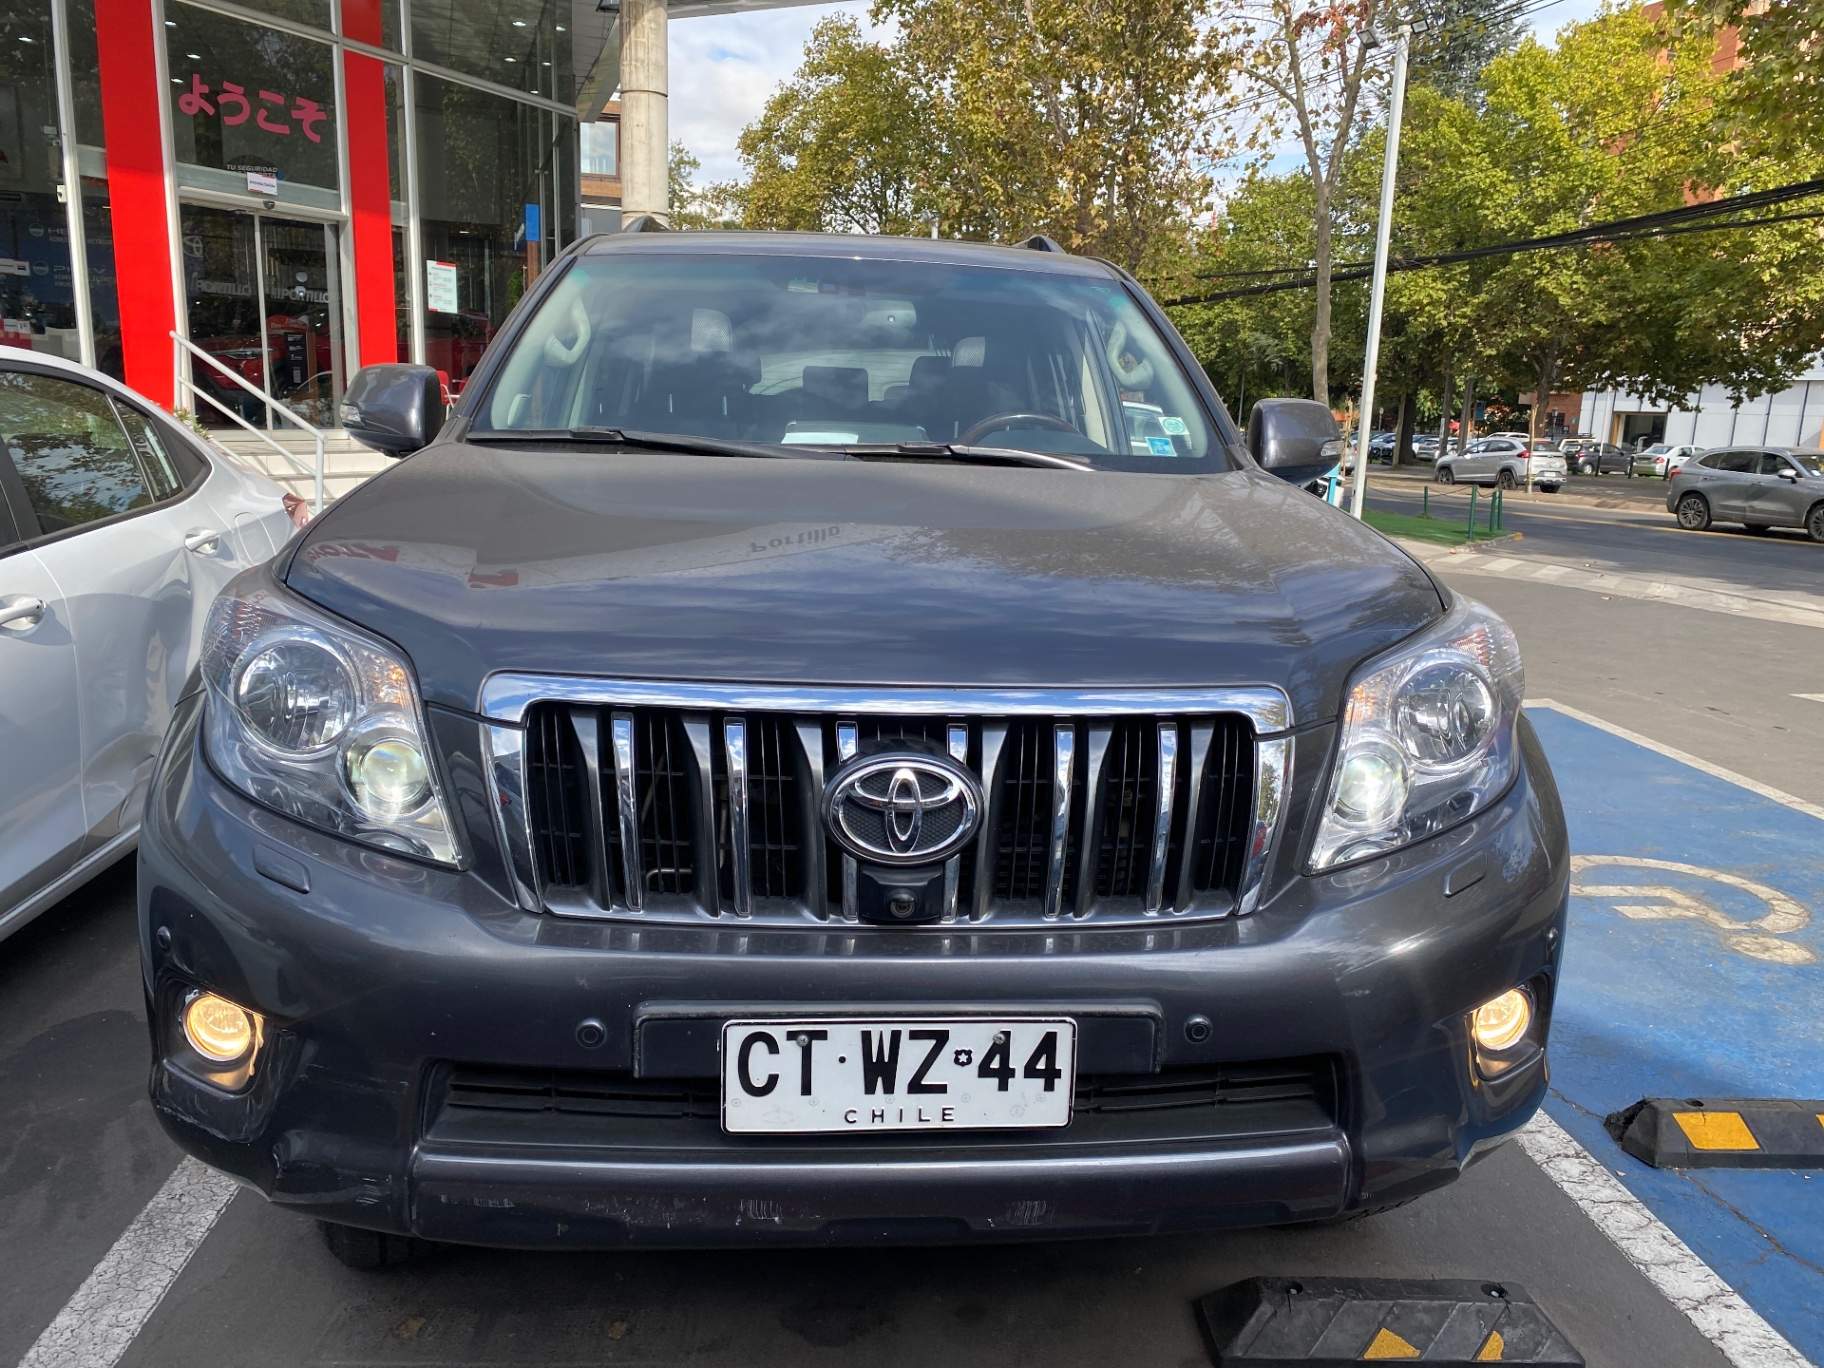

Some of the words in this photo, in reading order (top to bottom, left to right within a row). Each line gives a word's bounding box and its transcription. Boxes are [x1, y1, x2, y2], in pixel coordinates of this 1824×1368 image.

[178, 73, 328, 144] ようこそ
[844, 1107, 955, 1124] CHILE
